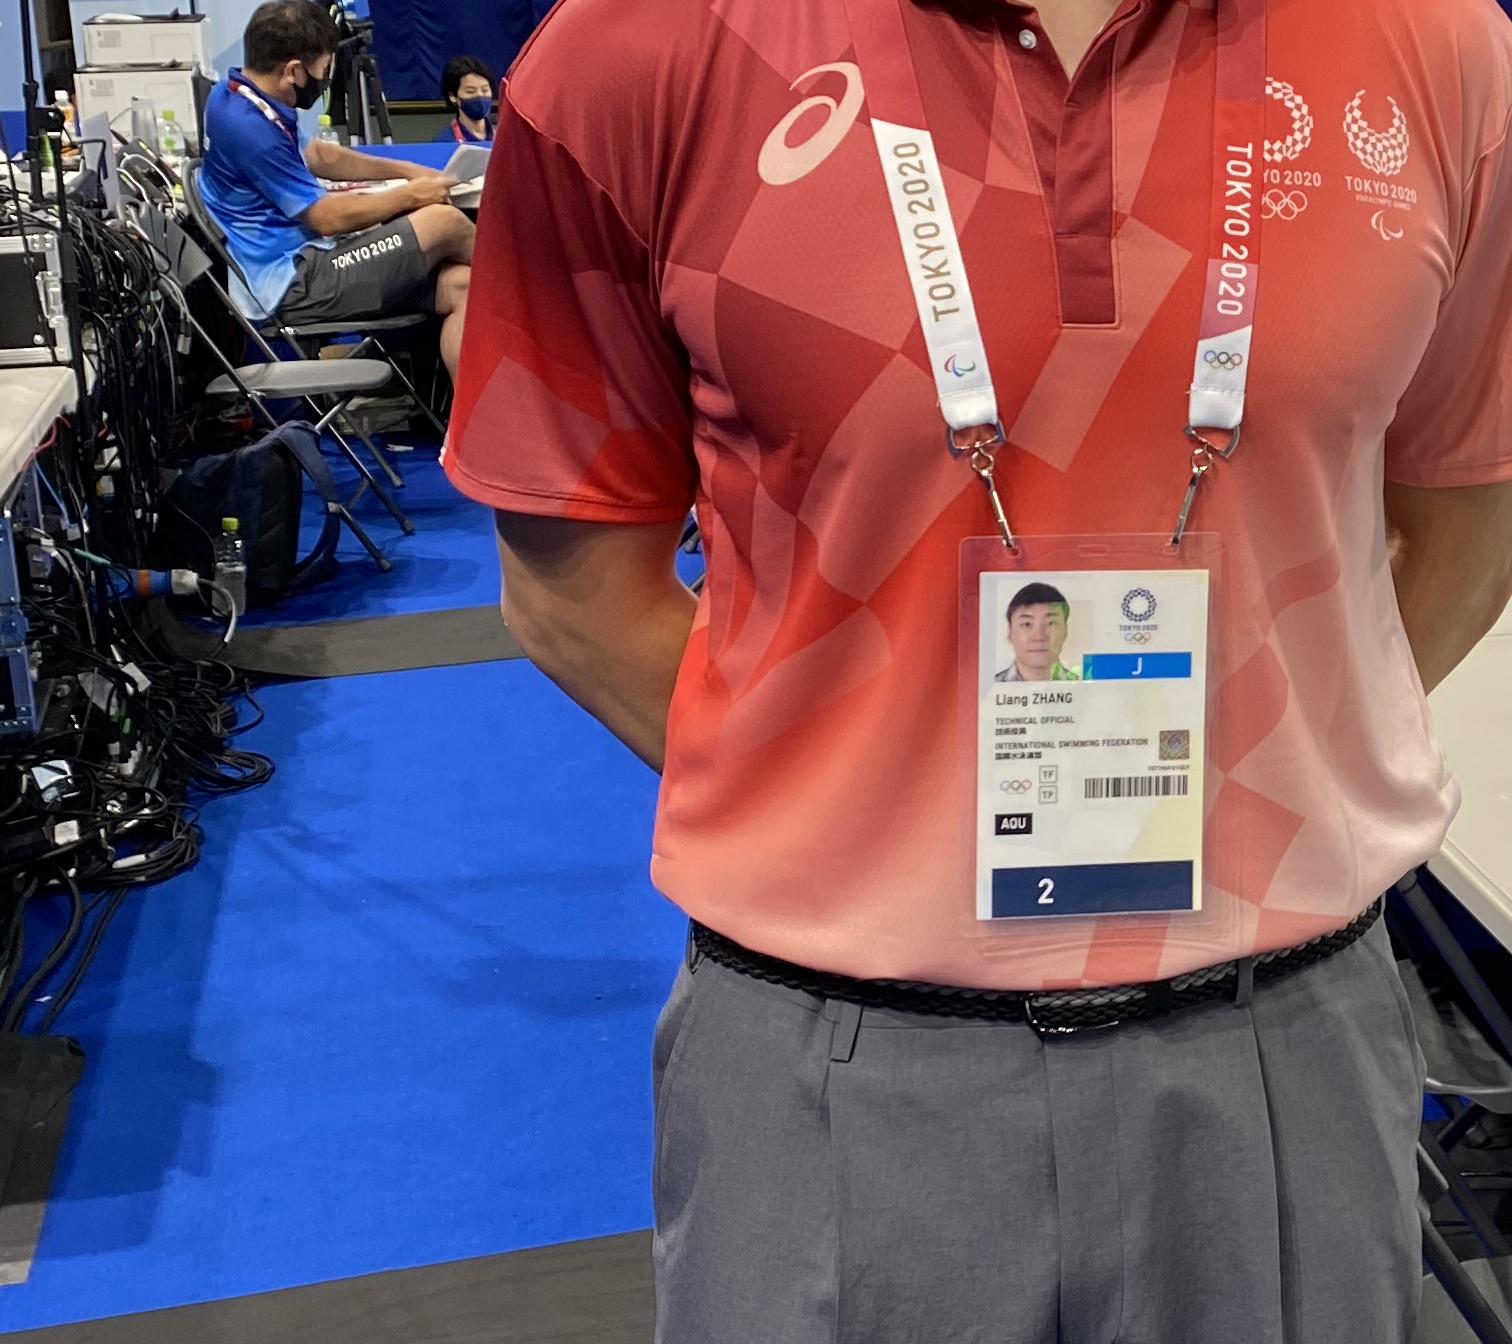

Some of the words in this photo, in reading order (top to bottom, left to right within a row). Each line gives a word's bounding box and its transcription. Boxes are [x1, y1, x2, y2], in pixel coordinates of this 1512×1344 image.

[892, 142, 936, 215] 2020
[1223, 142, 1253, 237] TOKYO
[1284, 170, 1322, 187] 2020
[1345, 175, 1388, 197] TOKYO
[1388, 184, 1417, 204] 2020
[331, 246, 370, 269] TOKYO
[369, 234, 402, 256] 2020
[913, 221, 960, 322] TOKYO
[1216, 243, 1249, 316] 2020
[1131, 657, 1143, 676] J
[996, 694, 1028, 706] Liang
[1032, 692, 1073, 704] ZHANG
[995, 717, 1038, 726] TECHNICAL
[1040, 715, 1075, 725] OFFICIAL
[995, 739, 1055, 750] INTERNATIONAL
[1058, 738, 1100, 749] SWIMMING
[1102, 737, 1149, 748] FEDERATION
[1043, 770, 1054, 778] TF
[1037, 878, 1055, 904] 2
